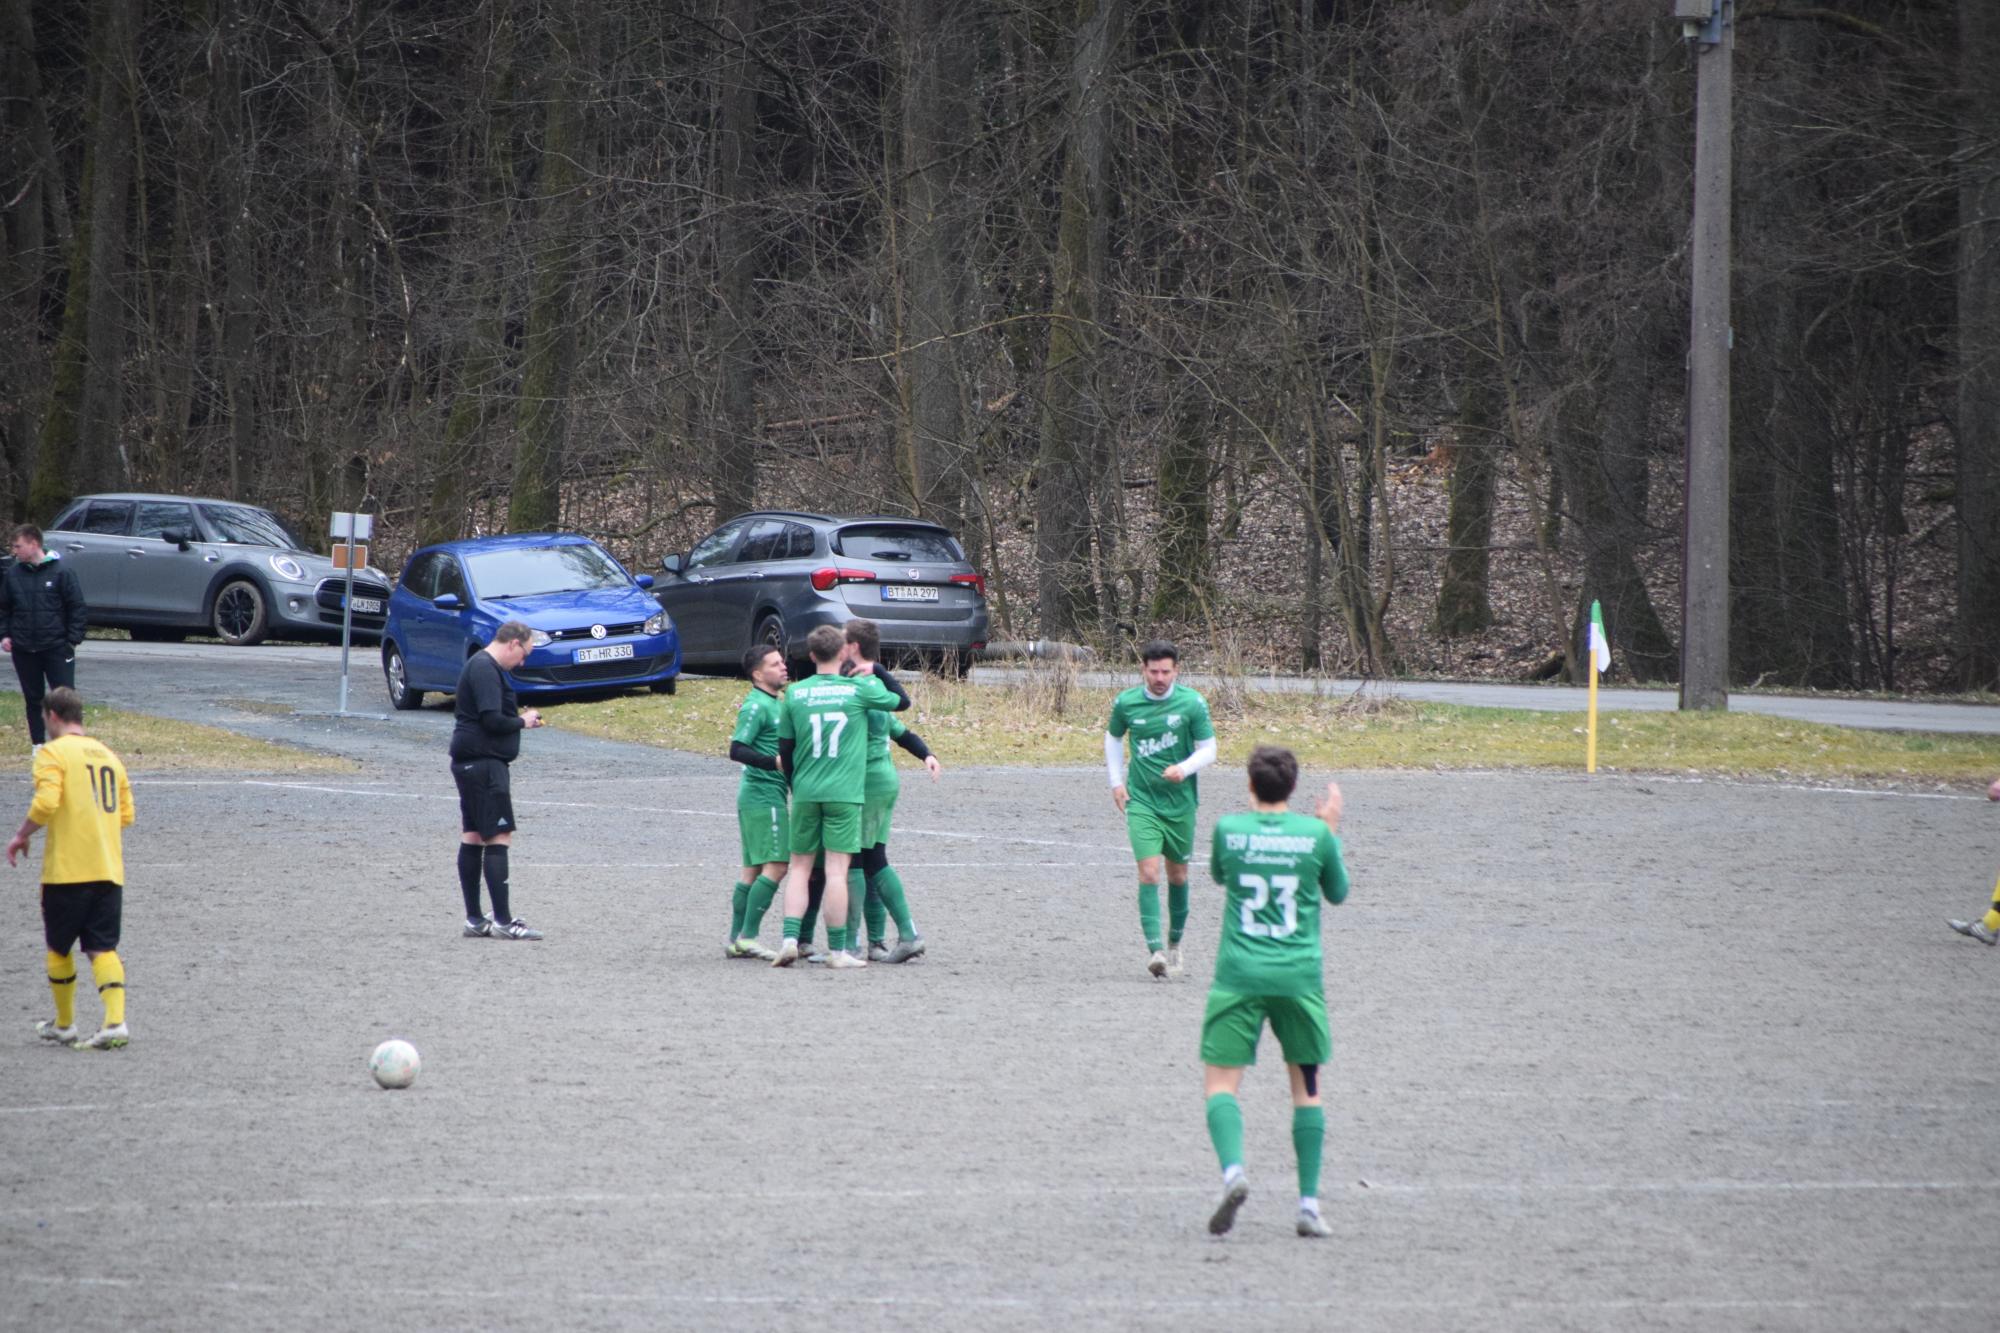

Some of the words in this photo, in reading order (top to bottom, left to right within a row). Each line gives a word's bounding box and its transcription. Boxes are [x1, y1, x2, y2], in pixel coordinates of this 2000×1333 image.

[888, 587, 899, 597] BT
[907, 588, 918, 597] AA
[921, 588, 937, 597] 297
[579, 650, 592, 660] BT
[599, 648, 611, 658] HR
[809, 711, 849, 758] 17
[86, 764, 117, 814] 10
[1239, 873, 1299, 939] 23
